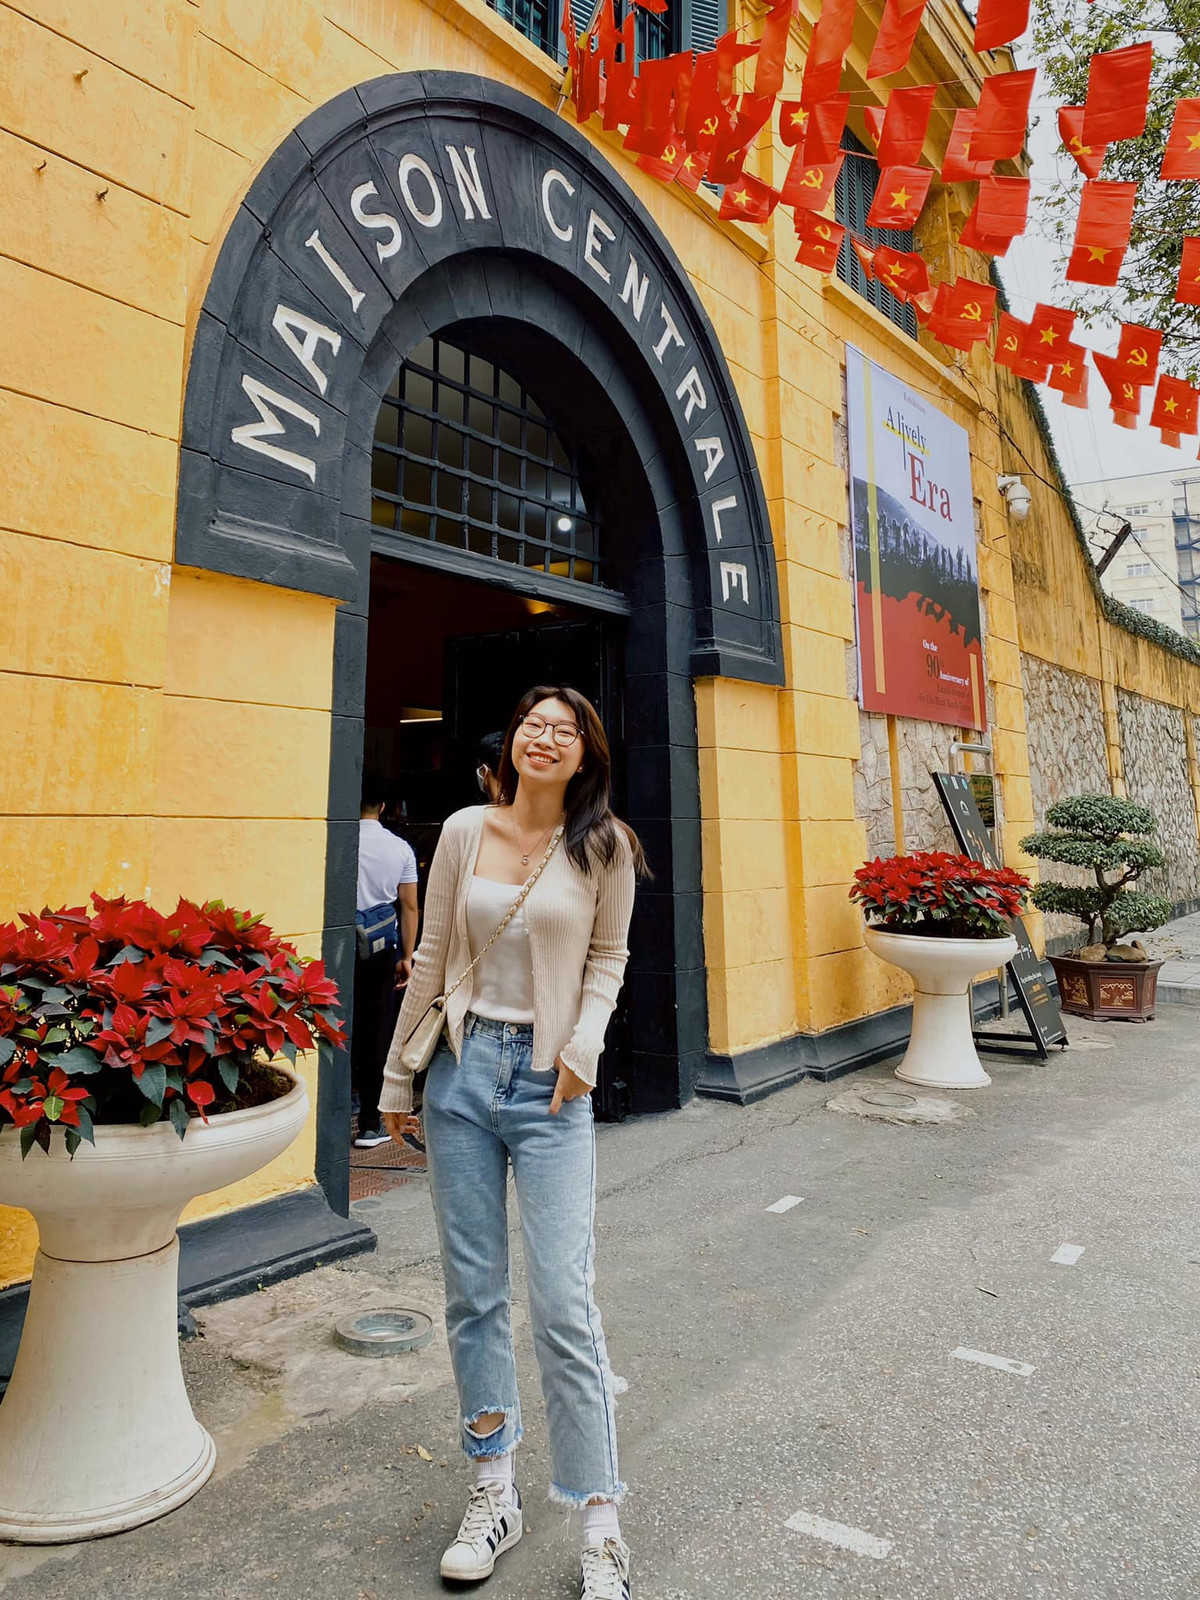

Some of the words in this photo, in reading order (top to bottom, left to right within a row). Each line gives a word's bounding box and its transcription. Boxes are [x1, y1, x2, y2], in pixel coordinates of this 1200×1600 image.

[231, 144, 493, 484] MAISON
[541, 168, 751, 606] CENTRALE
[886, 405, 896, 431] A
[897, 411, 927, 470] lively
[908, 451, 953, 522] Era
